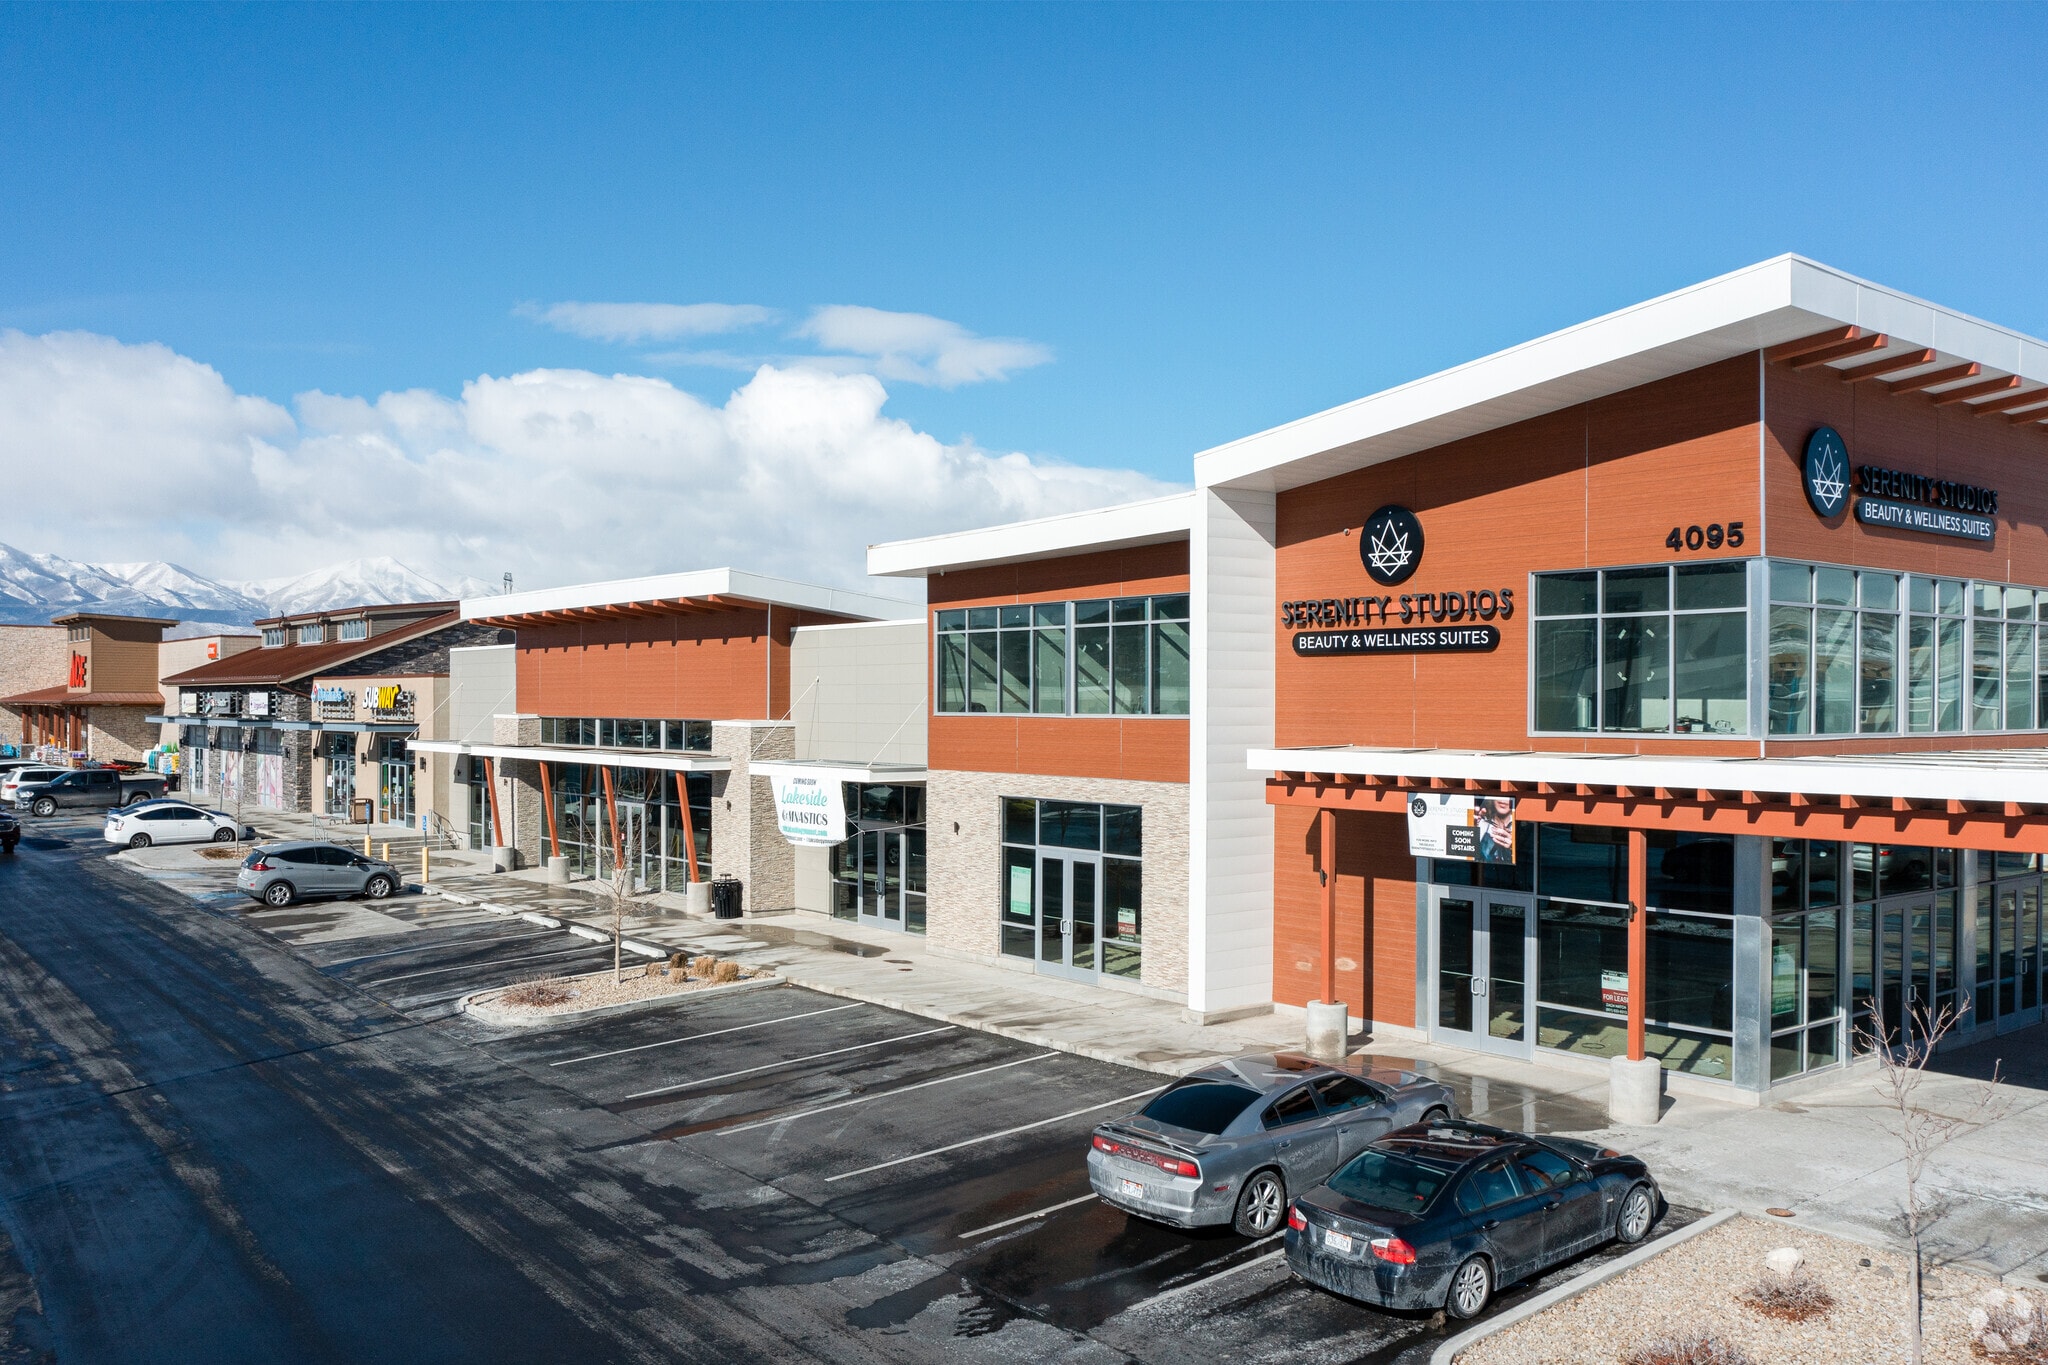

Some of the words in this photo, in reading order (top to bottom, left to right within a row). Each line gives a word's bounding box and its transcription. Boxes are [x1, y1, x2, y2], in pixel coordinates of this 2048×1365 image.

[1862, 465, 1935, 502] SERENITY
[1940, 480, 1999, 514] STUDIOS
[1865, 503, 1903, 523] BEAUTY
[1904, 508, 1912, 524] &
[1914, 511, 1960, 532] WELLNESS
[1962, 519, 1990, 537] SUITES
[1666, 522, 1744, 552] 4095
[1281, 595, 1391, 625] SERENITY
[1399, 588, 1513, 620] STUDIOS
[1299, 635, 1348, 649] BEAUTY
[1351, 634, 1361, 648] &
[1364, 632, 1436, 647] WELLNESS
[1439, 630, 1489, 645] SUITES
[70, 650, 87, 688] ACE
[363, 684, 400, 709] SUBWAY
[781, 785, 828, 807] Lakeside
[1451, 844, 1475, 852] UPSTAIRS
[1603, 993, 1614, 1001] FOR
[1614, 995, 1628, 1003] LEAS
